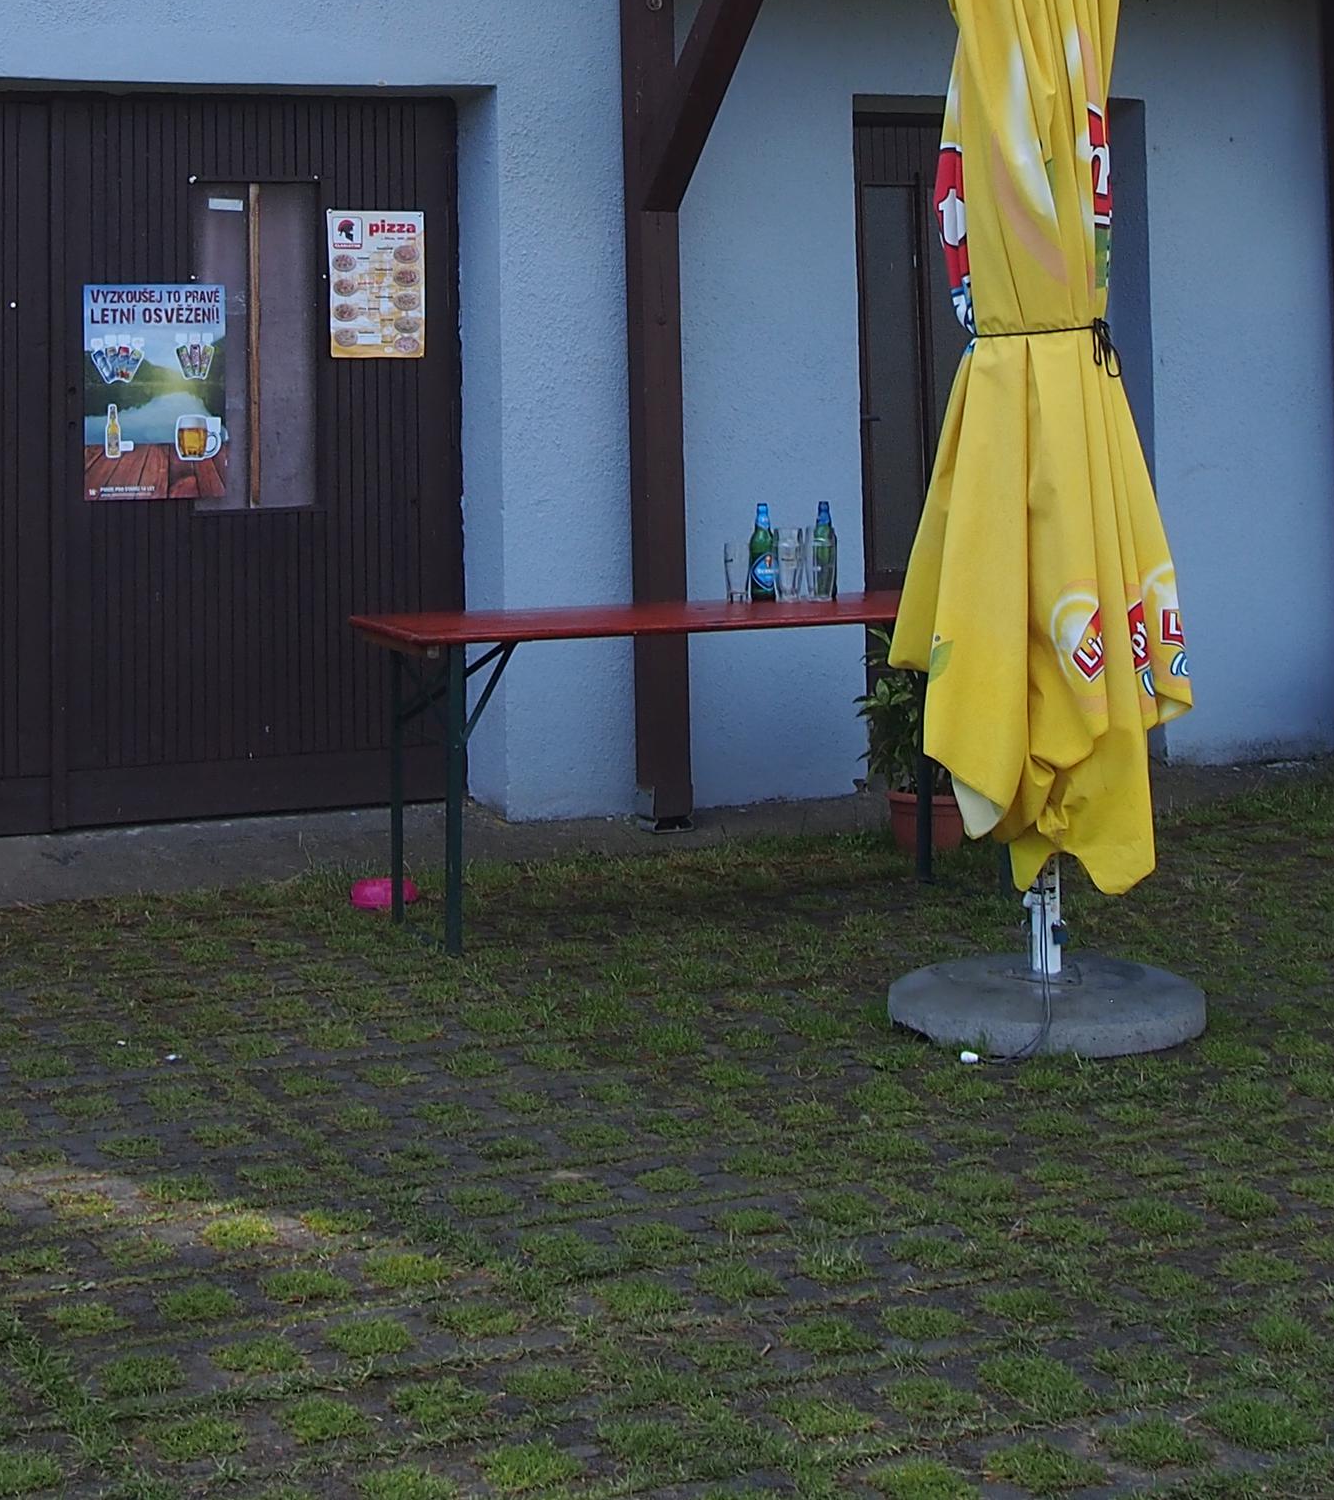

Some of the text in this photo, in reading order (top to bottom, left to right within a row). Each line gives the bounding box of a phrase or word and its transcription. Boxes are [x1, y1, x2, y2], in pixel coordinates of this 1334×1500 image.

[369, 219, 416, 236] pizza
[91, 287, 220, 304] VYZKOUŠEJ TO PRAVÉ
[91, 304, 220, 324] LETNÍ OSVĚŽENÍ!
